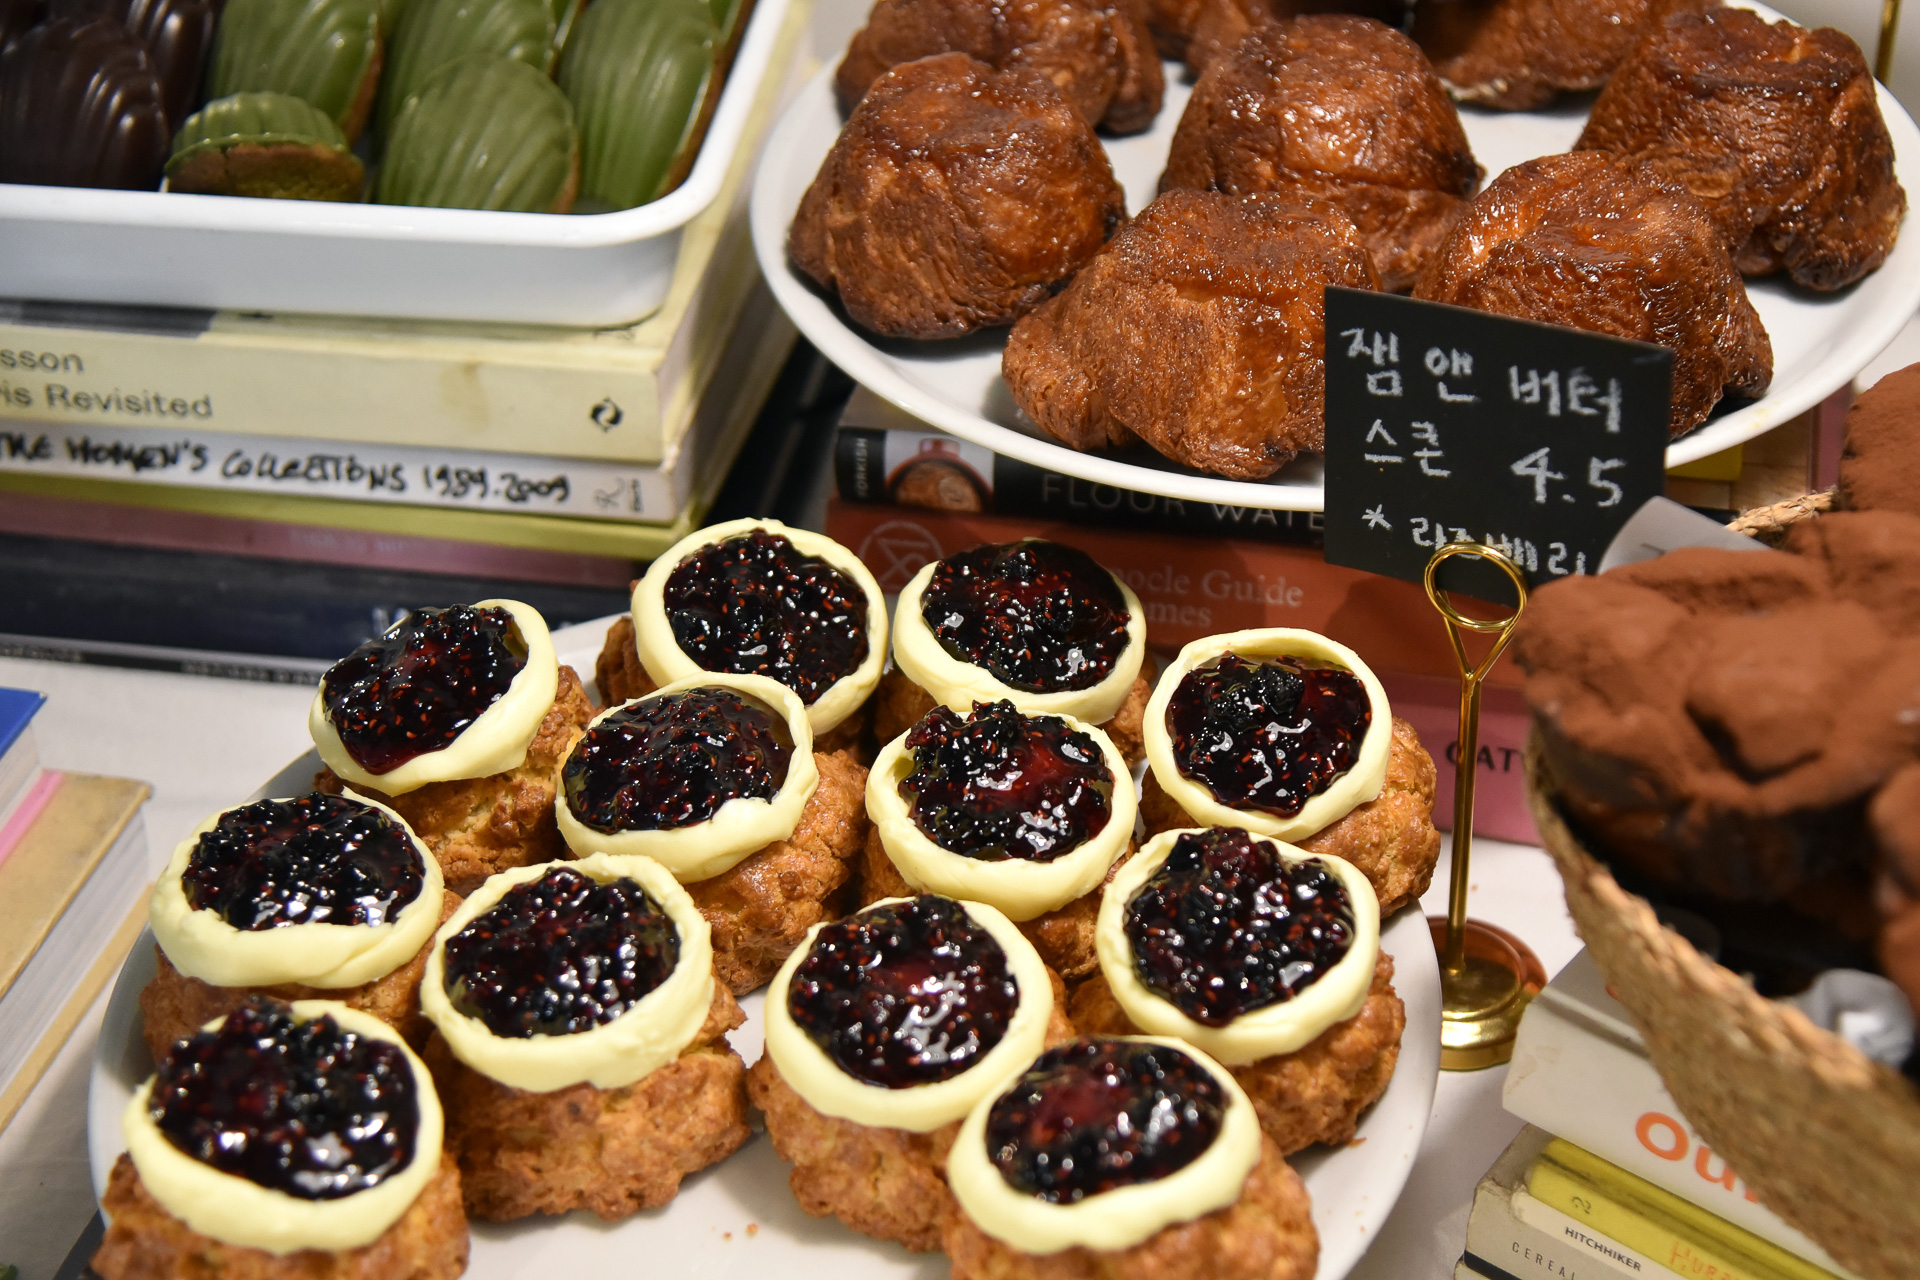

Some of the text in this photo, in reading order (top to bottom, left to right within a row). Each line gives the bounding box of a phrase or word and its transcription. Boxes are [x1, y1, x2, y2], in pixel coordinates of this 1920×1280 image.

[45, 383, 214, 418] Revisited
[1340, 327, 1623, 434] 잼 앤 버터
[1364, 418, 1628, 507] 스콘 4.5
[1042, 473, 1187, 516] FLOUR
[1201, 569, 1305, 607] Guide
[1143, 601, 1213, 628] mes
[1634, 1111, 1759, 1204] Ou
[1565, 1227, 1642, 1272] HITCHHIKER
